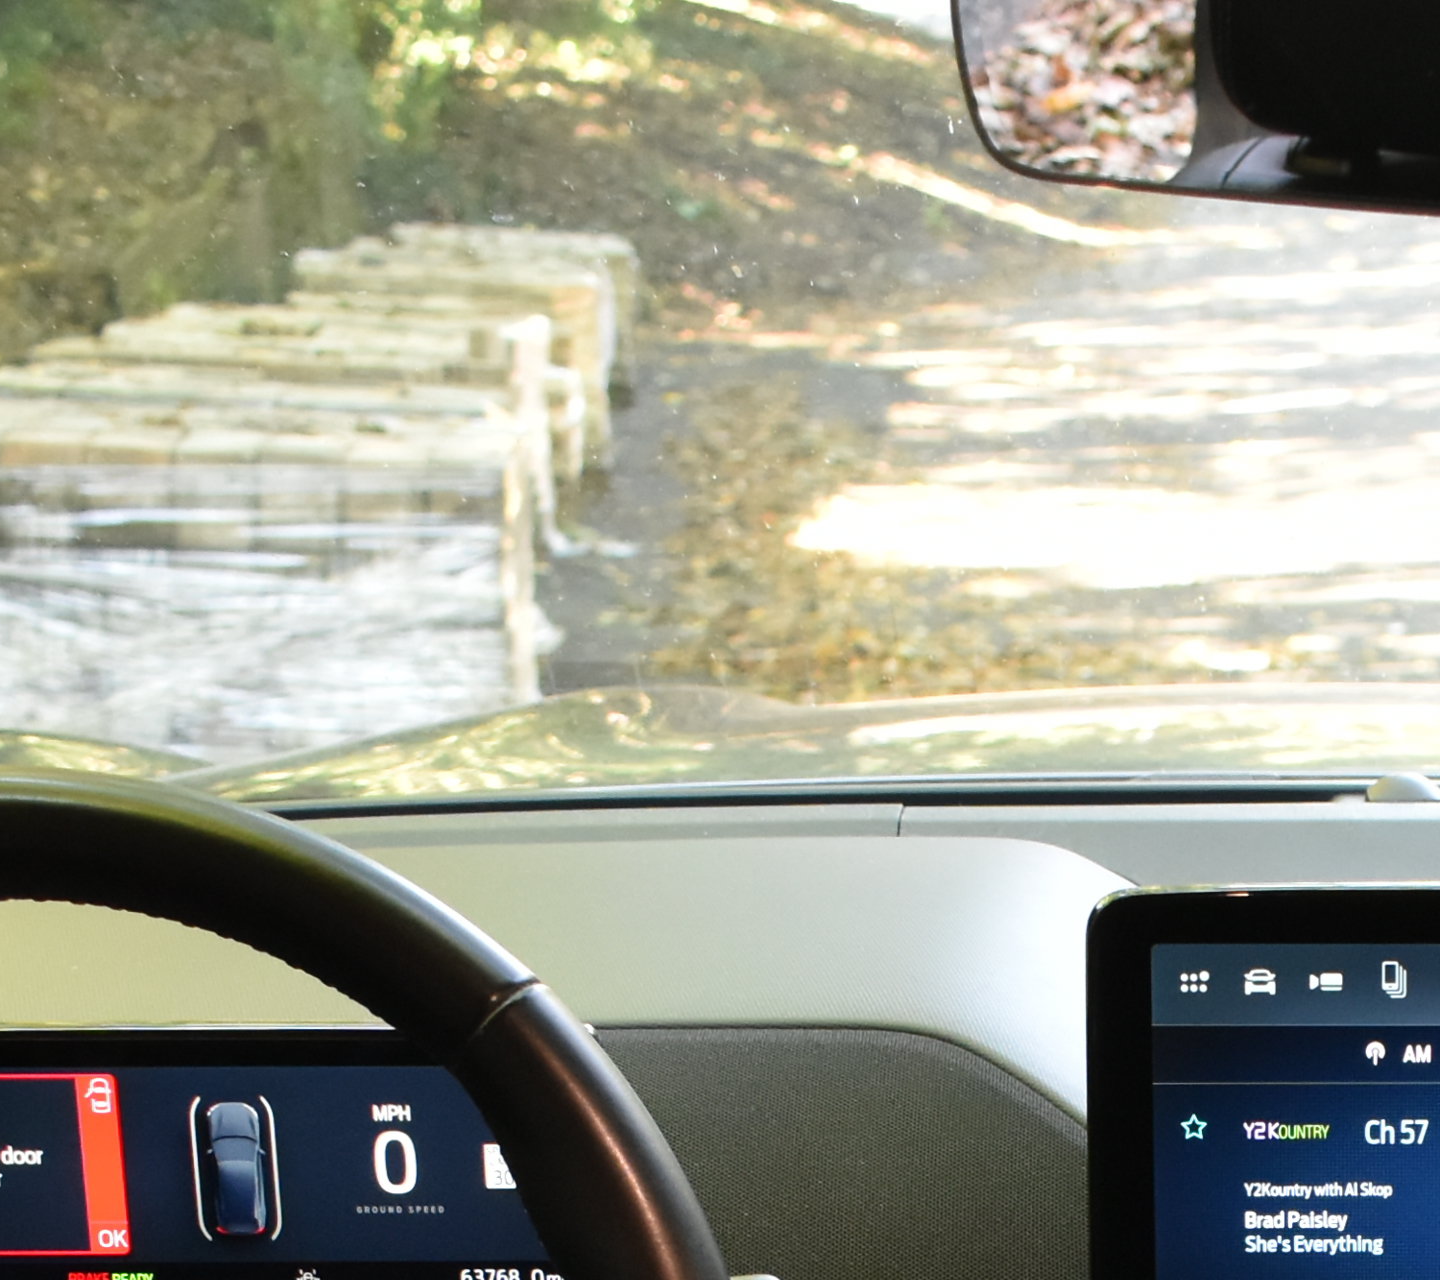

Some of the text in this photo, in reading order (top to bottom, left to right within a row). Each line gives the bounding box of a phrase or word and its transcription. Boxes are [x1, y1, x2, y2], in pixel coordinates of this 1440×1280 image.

[1403, 1044, 1432, 1064] AM
[371, 1104, 412, 1121] MPH
[1364, 1119, 1396, 1145] Ch
[1400, 1119, 1430, 1145] 57
[0, 1146, 44, 1165] door
[373, 1130, 417, 1195] 0
[496, 1169, 515, 1186] 30
[1243, 1182, 1312, 1199] Y2Kountry
[1314, 1182, 1343, 1197] with
[1360, 1182, 1393, 1199] Skop
[356, 1204, 446, 1215] GROUND SPEED
[1244, 1210, 1348, 1231] Brad Paisley
[98, 1229, 128, 1248] OK
[1244, 1235, 1384, 1255] She's Everything
